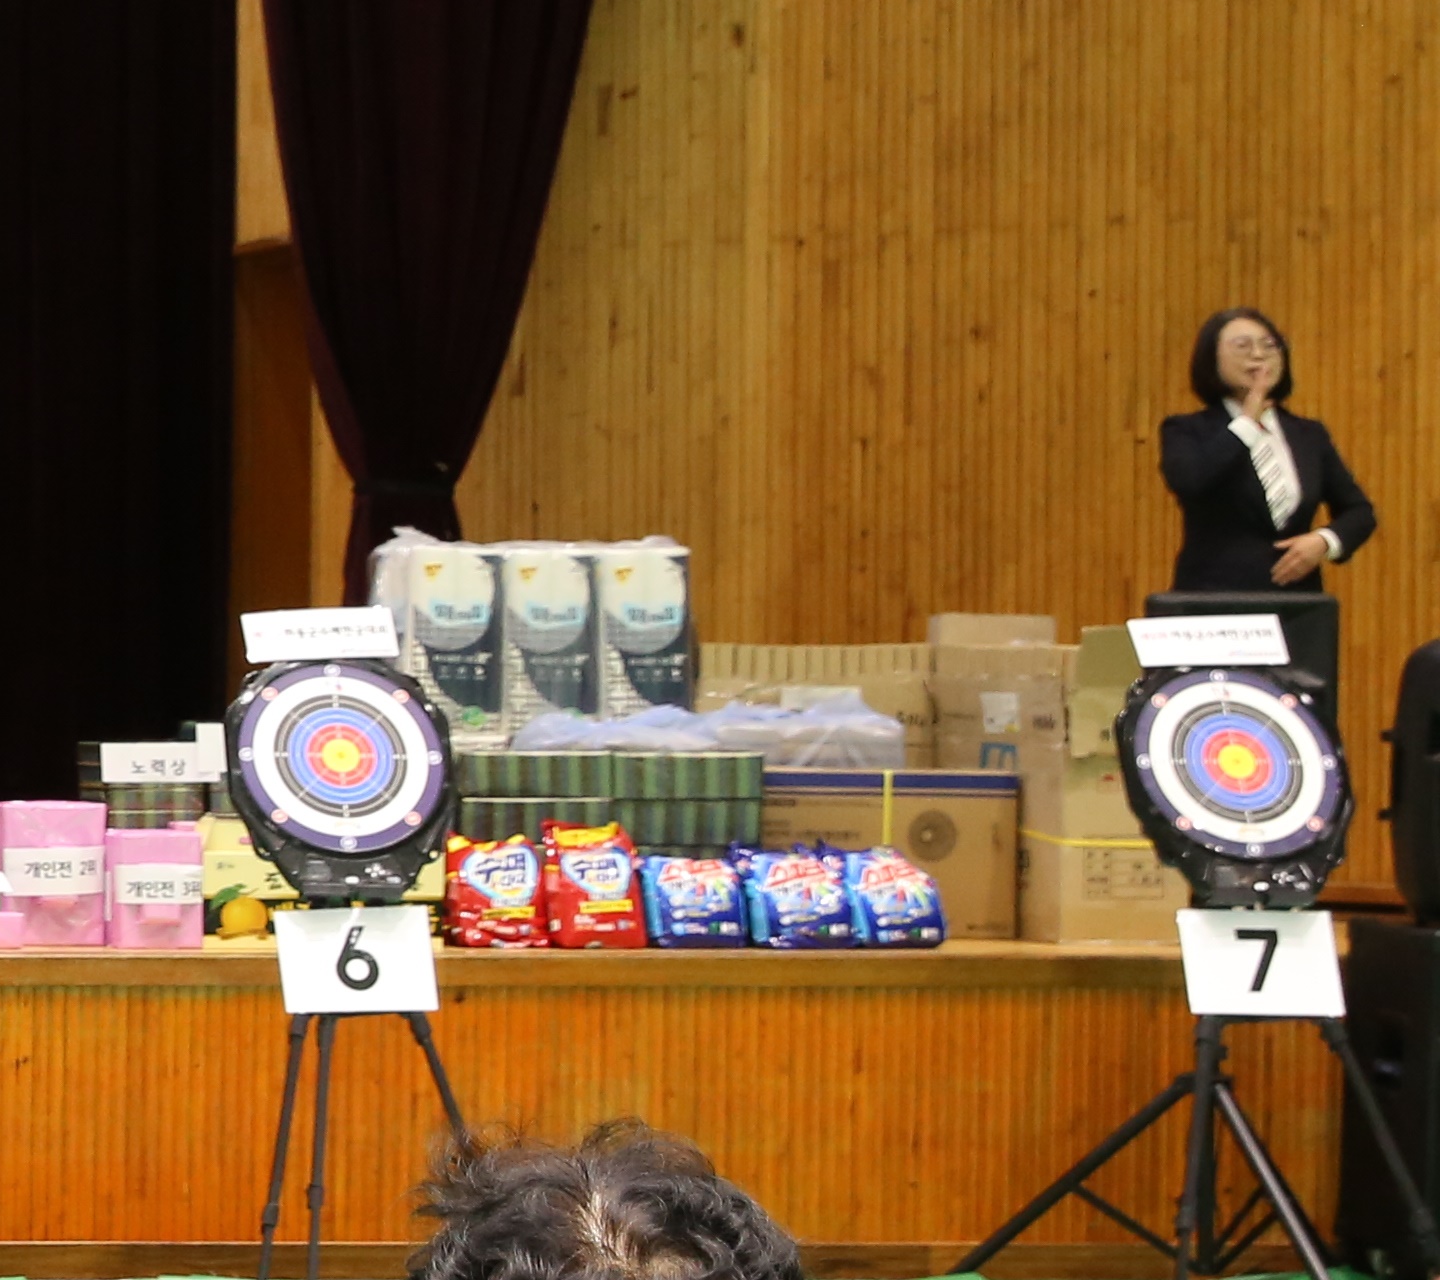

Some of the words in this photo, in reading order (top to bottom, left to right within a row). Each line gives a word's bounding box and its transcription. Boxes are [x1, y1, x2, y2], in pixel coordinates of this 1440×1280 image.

[24, 861, 72, 879] 개인전
[126, 880, 175, 898] 개인전
[336, 925, 380, 991] 6
[1233, 925, 1281, 992] 7
